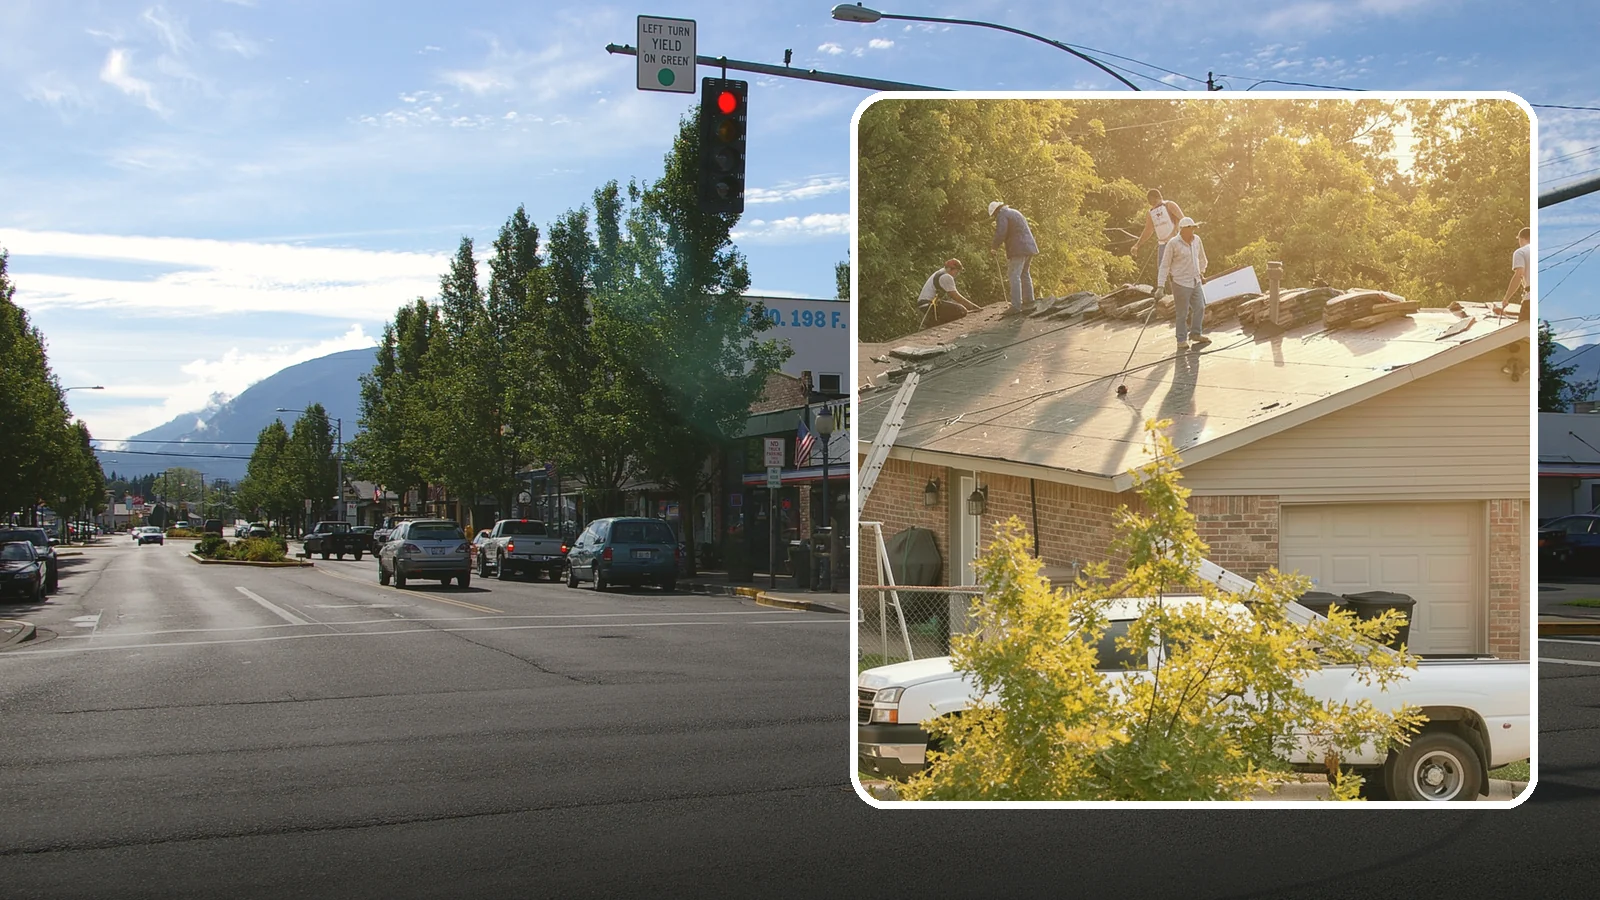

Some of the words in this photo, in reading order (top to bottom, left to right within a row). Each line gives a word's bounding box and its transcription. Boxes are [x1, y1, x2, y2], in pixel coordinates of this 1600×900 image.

[643, 23, 663, 34] LEFT
[668, 25, 690, 36] TURN
[652, 38, 682, 51] YIELD
[644, 53, 656, 64] ON
[661, 55, 689, 66] GREEN
[791, 309, 826, 328] 198
[831, 311, 847, 329] F.
